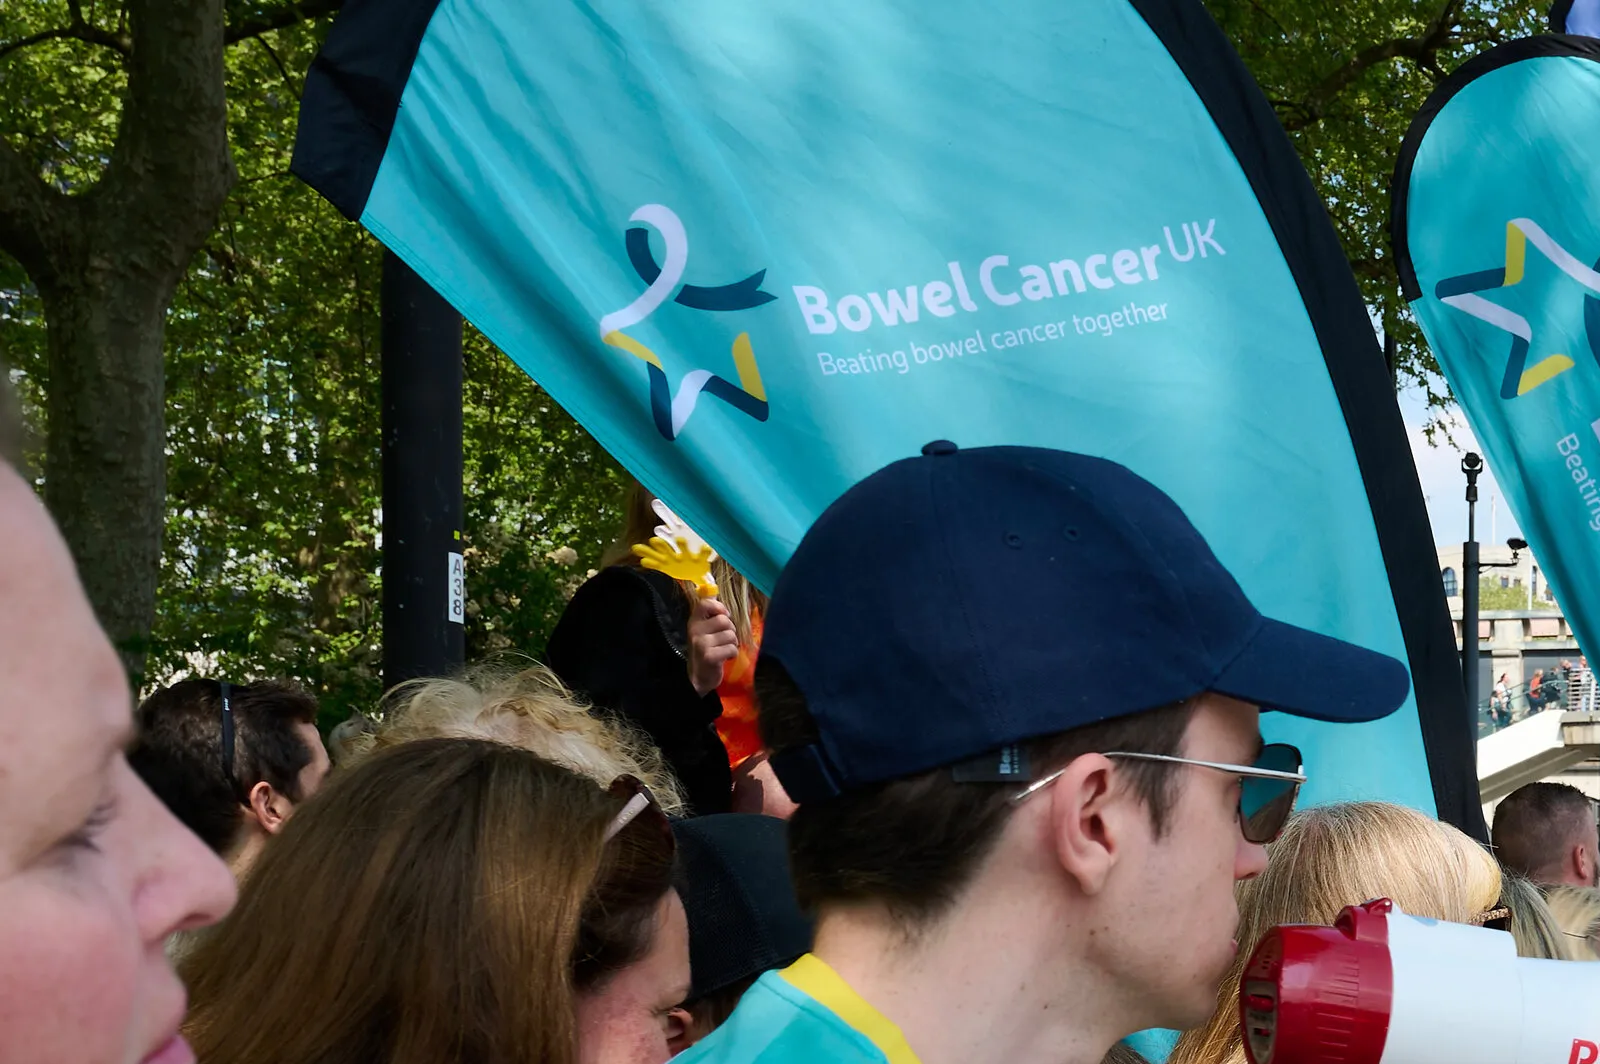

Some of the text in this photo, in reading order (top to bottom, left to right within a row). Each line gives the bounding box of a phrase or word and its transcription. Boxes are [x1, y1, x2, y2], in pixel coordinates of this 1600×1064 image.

[792, 218, 1227, 335] Bowel Cancer UK
[817, 299, 1168, 376] Beating bowel cancer together
[453, 558, 462, 616] A38
